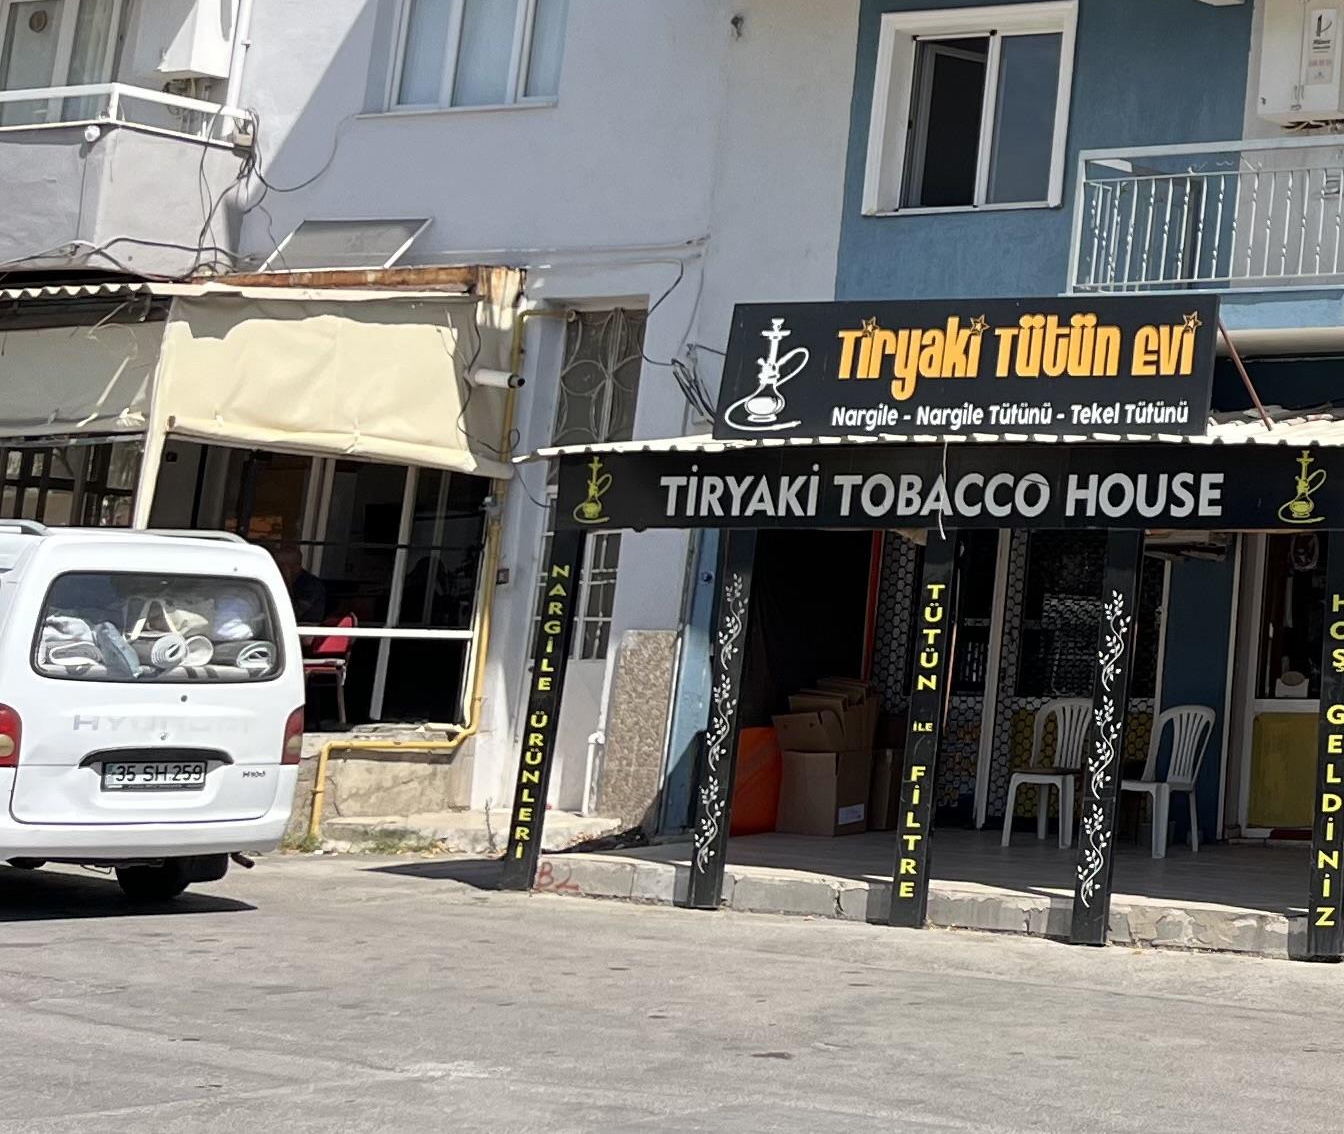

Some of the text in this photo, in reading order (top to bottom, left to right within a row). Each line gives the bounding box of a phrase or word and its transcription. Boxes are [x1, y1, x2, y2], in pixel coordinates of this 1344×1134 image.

[995, 313, 1123, 378] Tütün
[831, 405, 898, 431] Nargile
[916, 403, 983, 431] Nargile
[990, 401, 1052, 425] Tütünü
[1071, 403, 1120, 424] Tekel
[1125, 399, 1188, 423] Tütünü
[659, 463, 1224, 519] TİRYAKİ TOBACCO HOUSE
[536, 564, 570, 692] NARGİLE
[917, 584, 946, 691] TÜTÜN
[912, 720, 933, 732] İLE
[115, 764, 202, 782] 35 SH 259
[514, 710, 549, 859] ÜRÜNLERİ
[899, 765, 926, 898] FİLTRE
